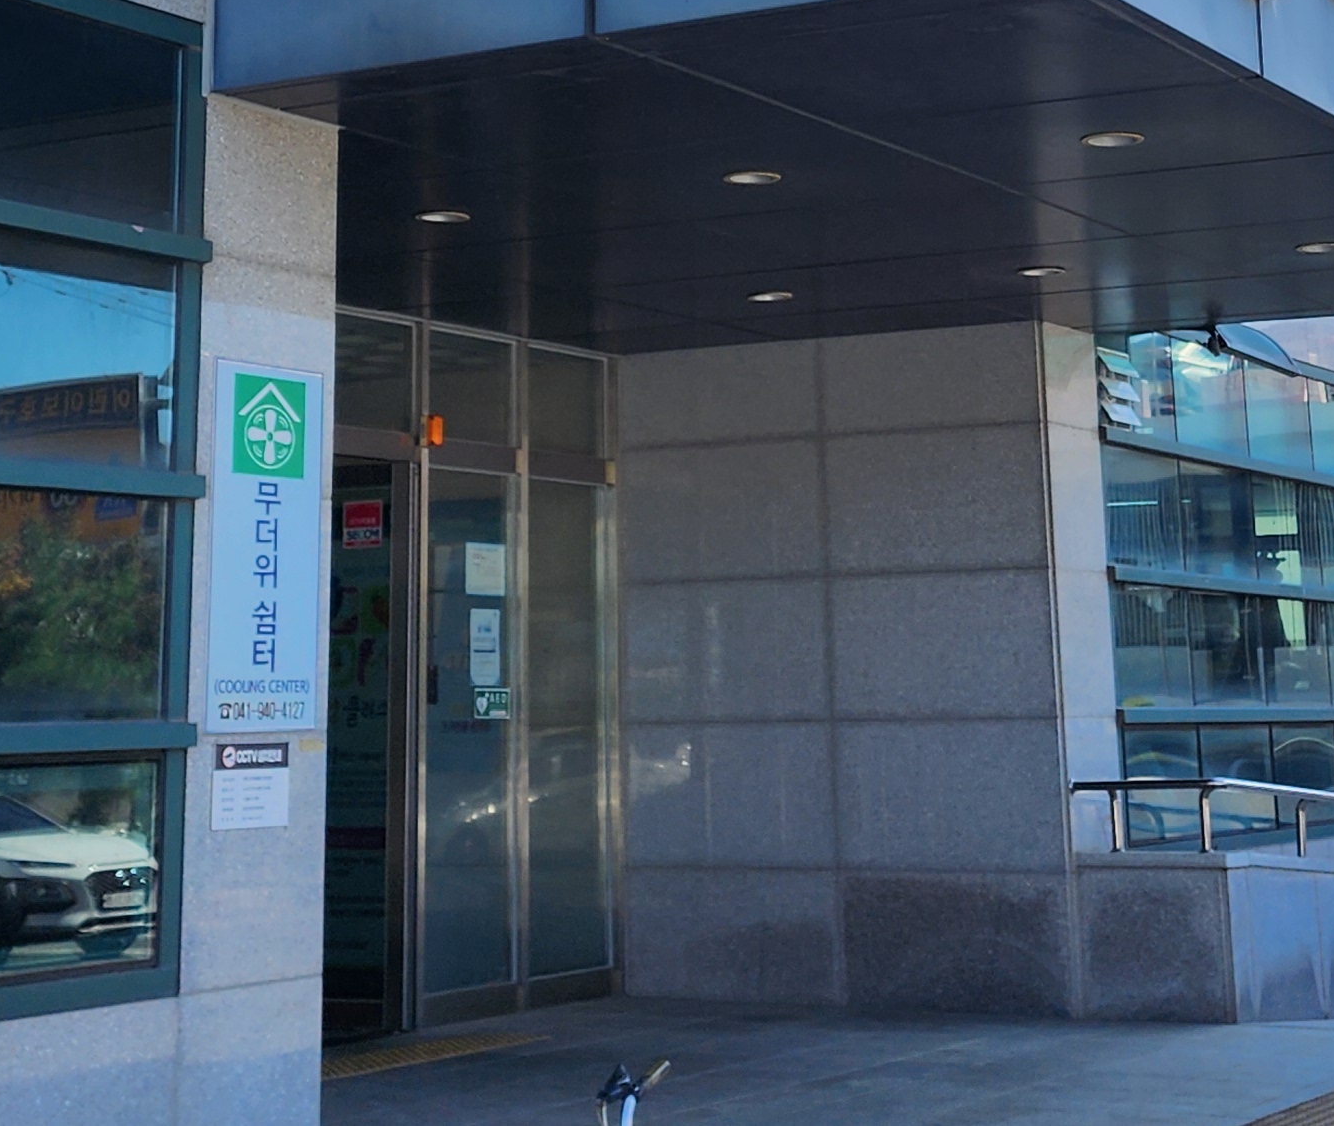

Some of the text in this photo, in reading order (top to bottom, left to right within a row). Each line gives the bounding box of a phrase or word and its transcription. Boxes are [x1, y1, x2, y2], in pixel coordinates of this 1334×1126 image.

[254, 482, 281, 590] 무더위
[252, 601, 277, 673] 쉼터
[214, 678, 310, 694] (COOLING CENTER)
